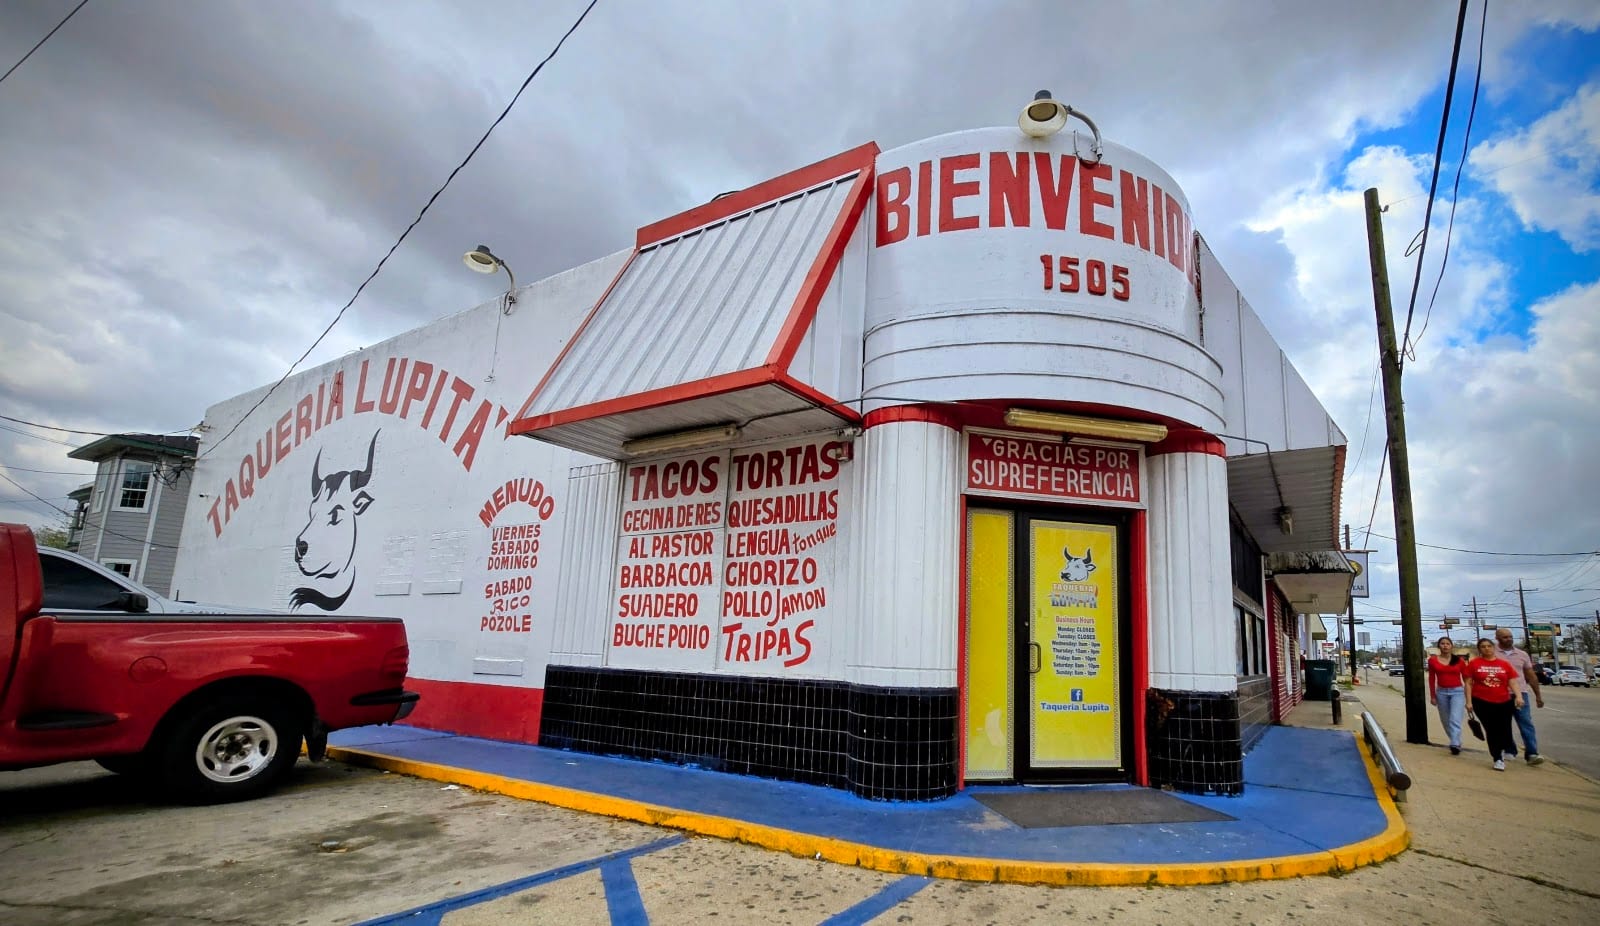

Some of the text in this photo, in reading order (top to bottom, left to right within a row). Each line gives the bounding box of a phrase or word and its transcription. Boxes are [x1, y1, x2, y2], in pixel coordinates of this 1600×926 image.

[1040, 254, 1130, 302] 1505
[206, 370, 345, 538] TAQUERIA
[733, 441, 840, 492] TORTAS
[992, 439, 1129, 470] GRACIAS POR
[629, 455, 721, 502] TACOS
[971, 458, 1135, 498] SU PREFERENCIA
[478, 477, 555, 529] MENUDO
[623, 501, 721, 532] CECINA DE RES
[727, 489, 838, 528] QUESADILLAS
[491, 539, 539, 556] SABADO
[492, 524, 541, 541] VIERNES
[629, 531, 714, 559] AL PASTOR
[726, 528, 791, 559] LENGUA
[487, 555, 538, 571] DOMINGO
[620, 561, 713, 588] BARBACOA
[725, 557, 817, 587] CHORIZO
[485, 575, 532, 599] SABADO
[490, 595, 530, 615] RICO
[618, 592, 698, 618] SUADERO
[722, 587, 826, 627] POLLO JAMON
[480, 614, 532, 632] POZOLE
[613, 622, 665, 648] BUCHE
[722, 619, 814, 668] TRIPAS
[1040, 702, 1109, 712] Taqueria Lupita
